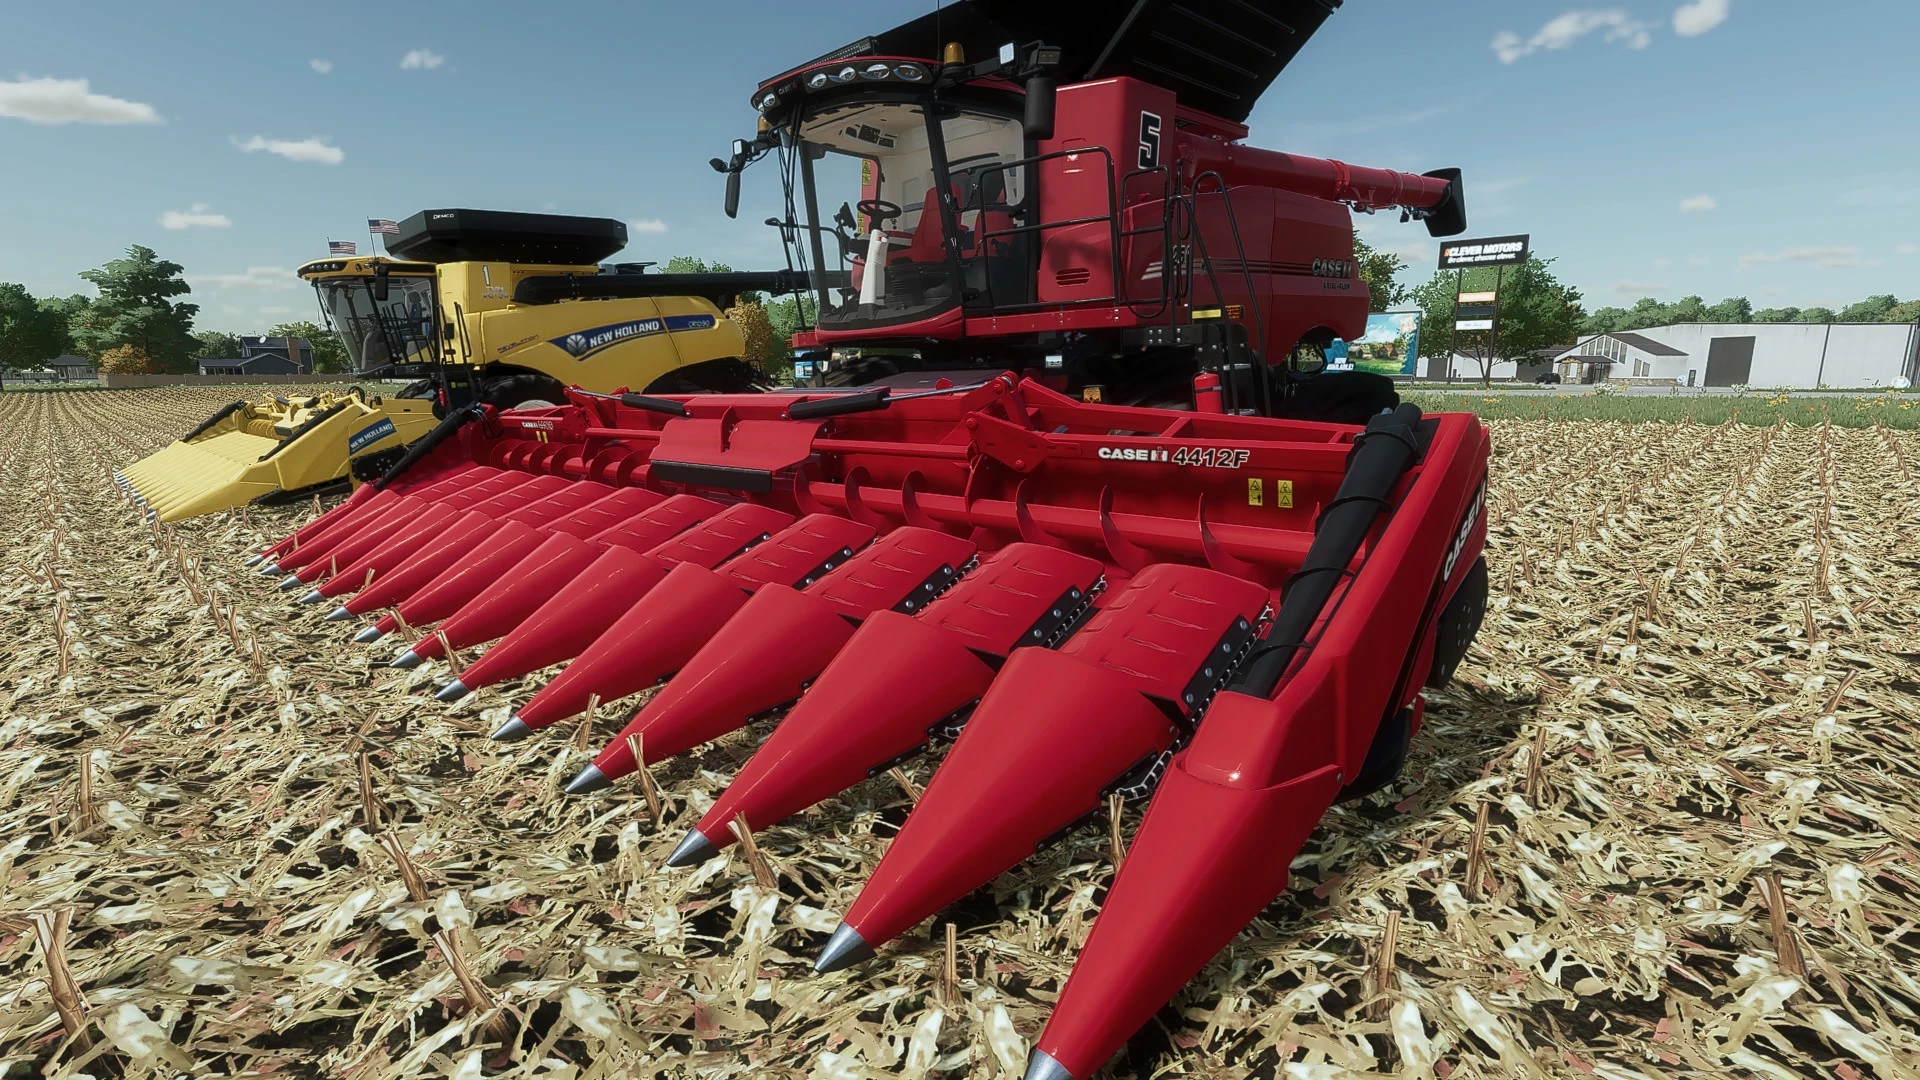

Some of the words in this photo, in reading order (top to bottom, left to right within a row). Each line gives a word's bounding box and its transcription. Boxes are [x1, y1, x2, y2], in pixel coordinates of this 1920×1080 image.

[1138, 110, 1161, 173] 5
[1449, 244, 1483, 257] CLEVER
[1482, 241, 1523, 254] MOTORS
[482, 264, 491, 287] 1
[1312, 257, 1343, 277] CASE
[590, 331, 613, 348] NEW
[615, 320, 660, 338] HOLLAND
[350, 436, 365, 449] NEW
[363, 423, 393, 440] HOLLAND
[1098, 447, 1149, 461] CASE
[1171, 446, 1250, 469] 4412F
[1444, 502, 1476, 581] CASE
